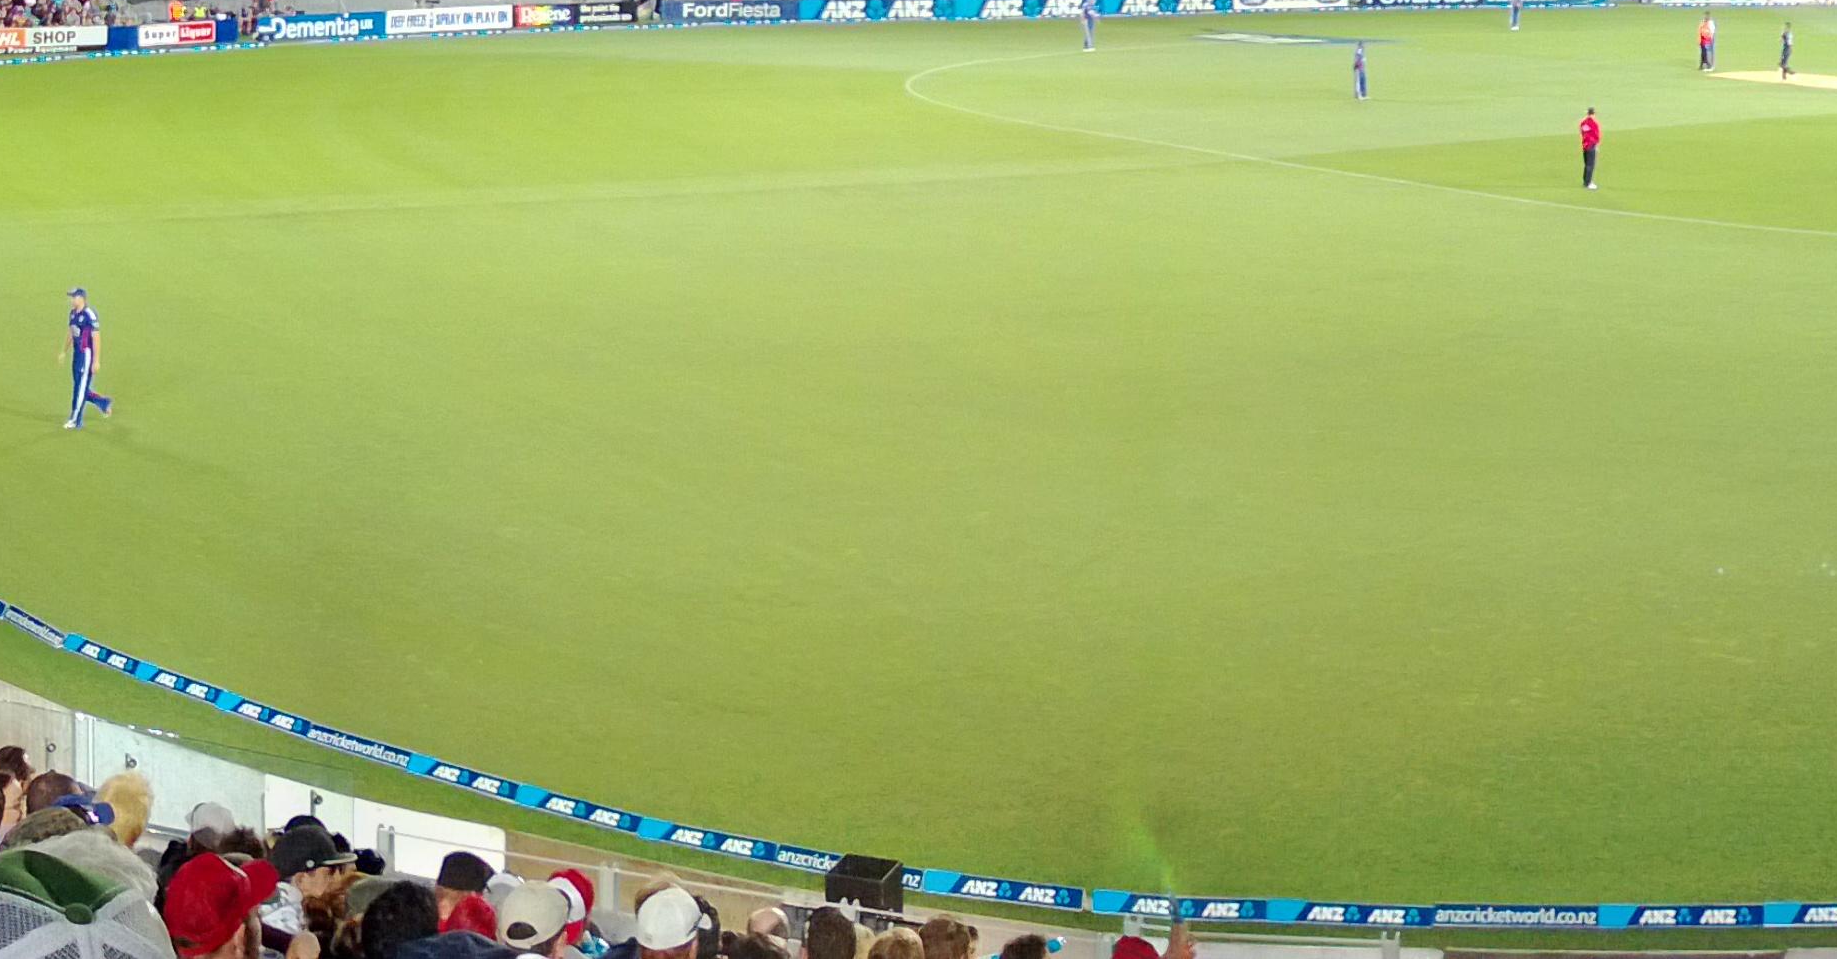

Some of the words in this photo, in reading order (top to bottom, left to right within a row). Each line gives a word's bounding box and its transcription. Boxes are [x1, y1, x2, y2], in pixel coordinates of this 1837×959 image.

[822, 0, 866, 19] ANZ
[145, 28, 177, 41] Super
[180, 25, 213, 42] Liquor
[270, 14, 359, 39] Dementia
[32, 31, 77, 45] SHOP
[308, 727, 410, 768] anzcricketworld.co.nz
[472, 776, 501, 794] ANZ
[546, 796, 576, 815] ANZ
[589, 808, 620, 827] ANZ
[670, 828, 703, 846] ANZ
[720, 837, 753, 855] ANZ
[961, 880, 998, 897] ANZ
[1018, 885, 1056, 903] ANZ
[1131, 897, 1171, 914] ANZ
[1202, 901, 1240, 918] ANZ
[1307, 906, 1345, 922] ANZ
[1367, 908, 1406, 923] ANZ
[1435, 907, 1598, 925] anzcricketworld.co.nz
[1639, 909, 1677, 924] ANZ
[1700, 908, 1737, 924] ANZ
